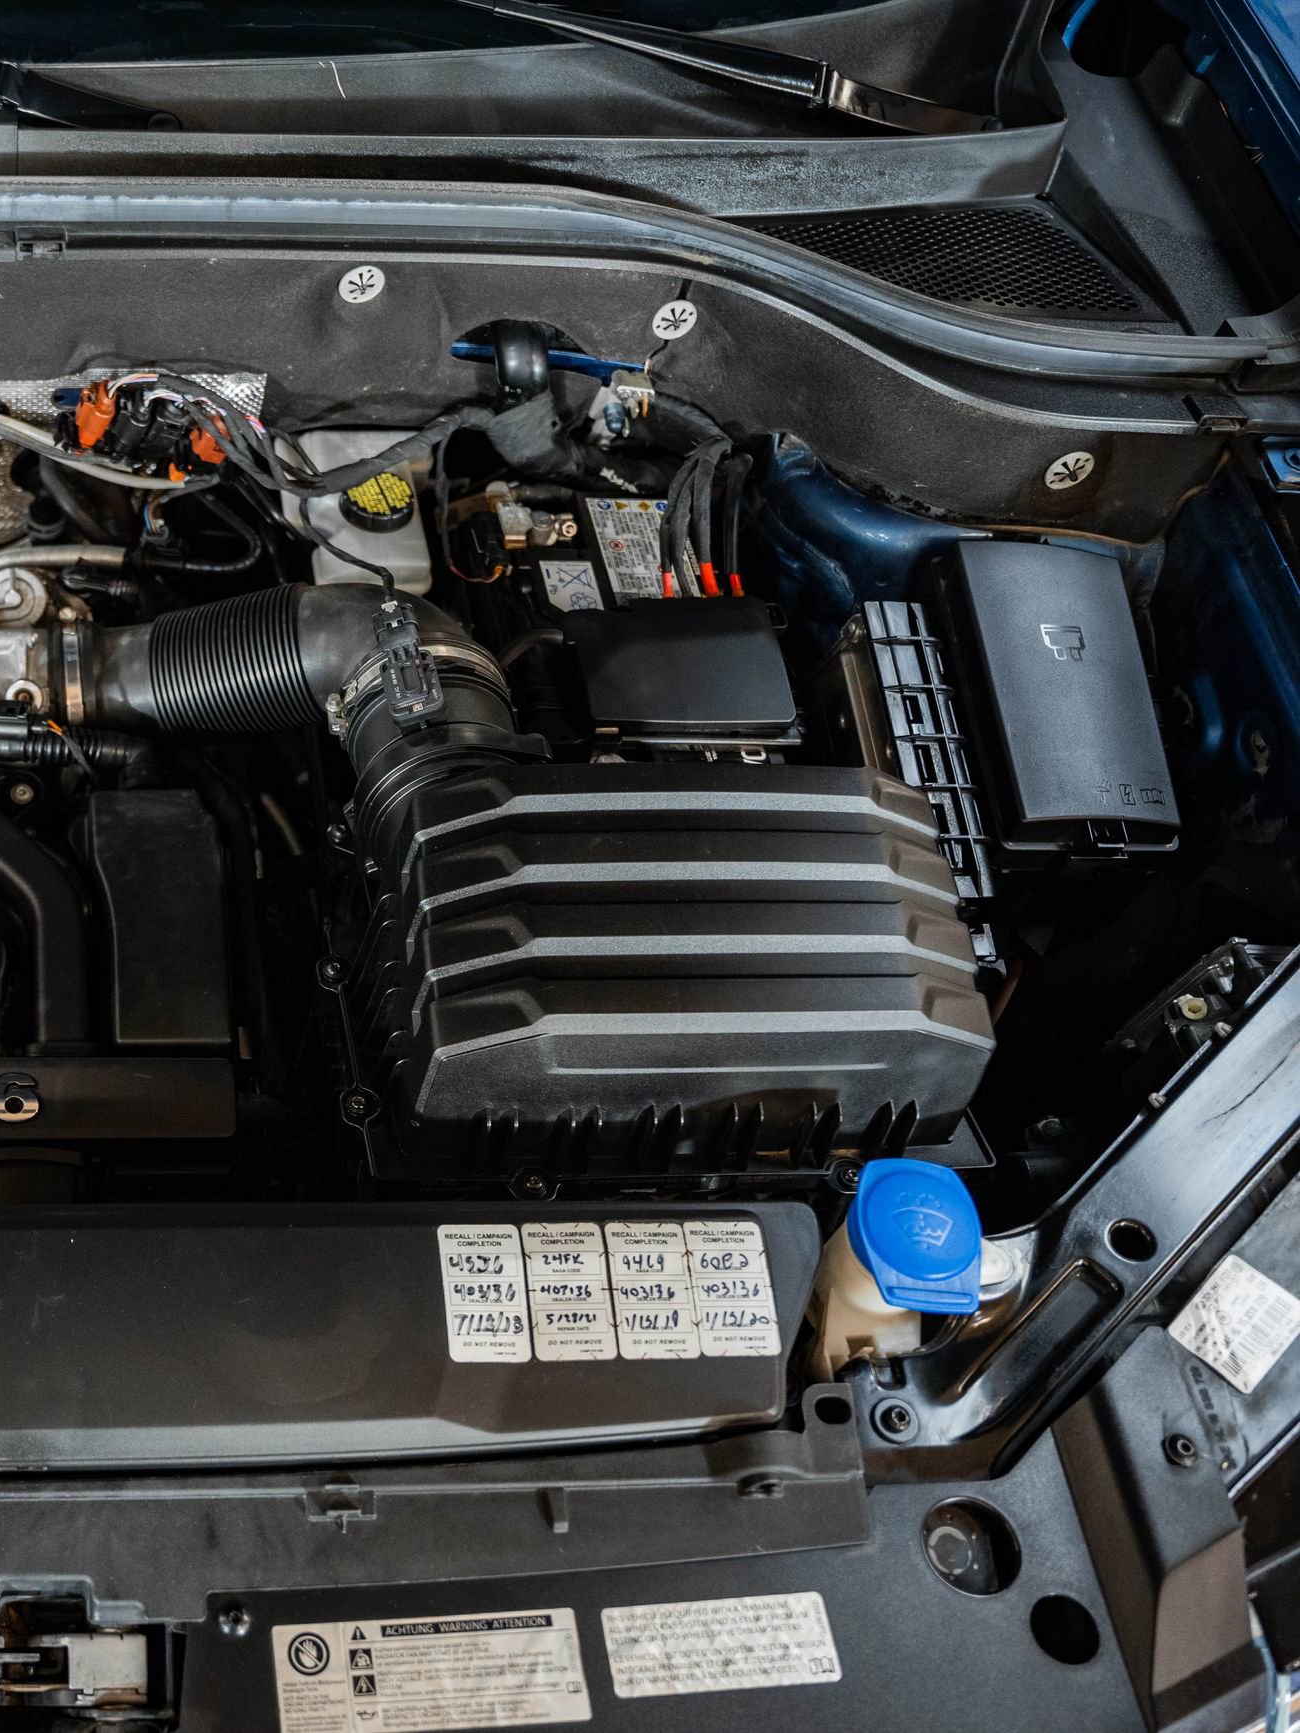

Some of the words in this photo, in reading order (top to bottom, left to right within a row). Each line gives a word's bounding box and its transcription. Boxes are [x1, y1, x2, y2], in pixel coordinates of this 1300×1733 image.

[384, 1624, 434, 1635] ACHTUNG
[439, 1620, 488, 1632] WARNING
[492, 1616, 546, 1628] ATTENTION
